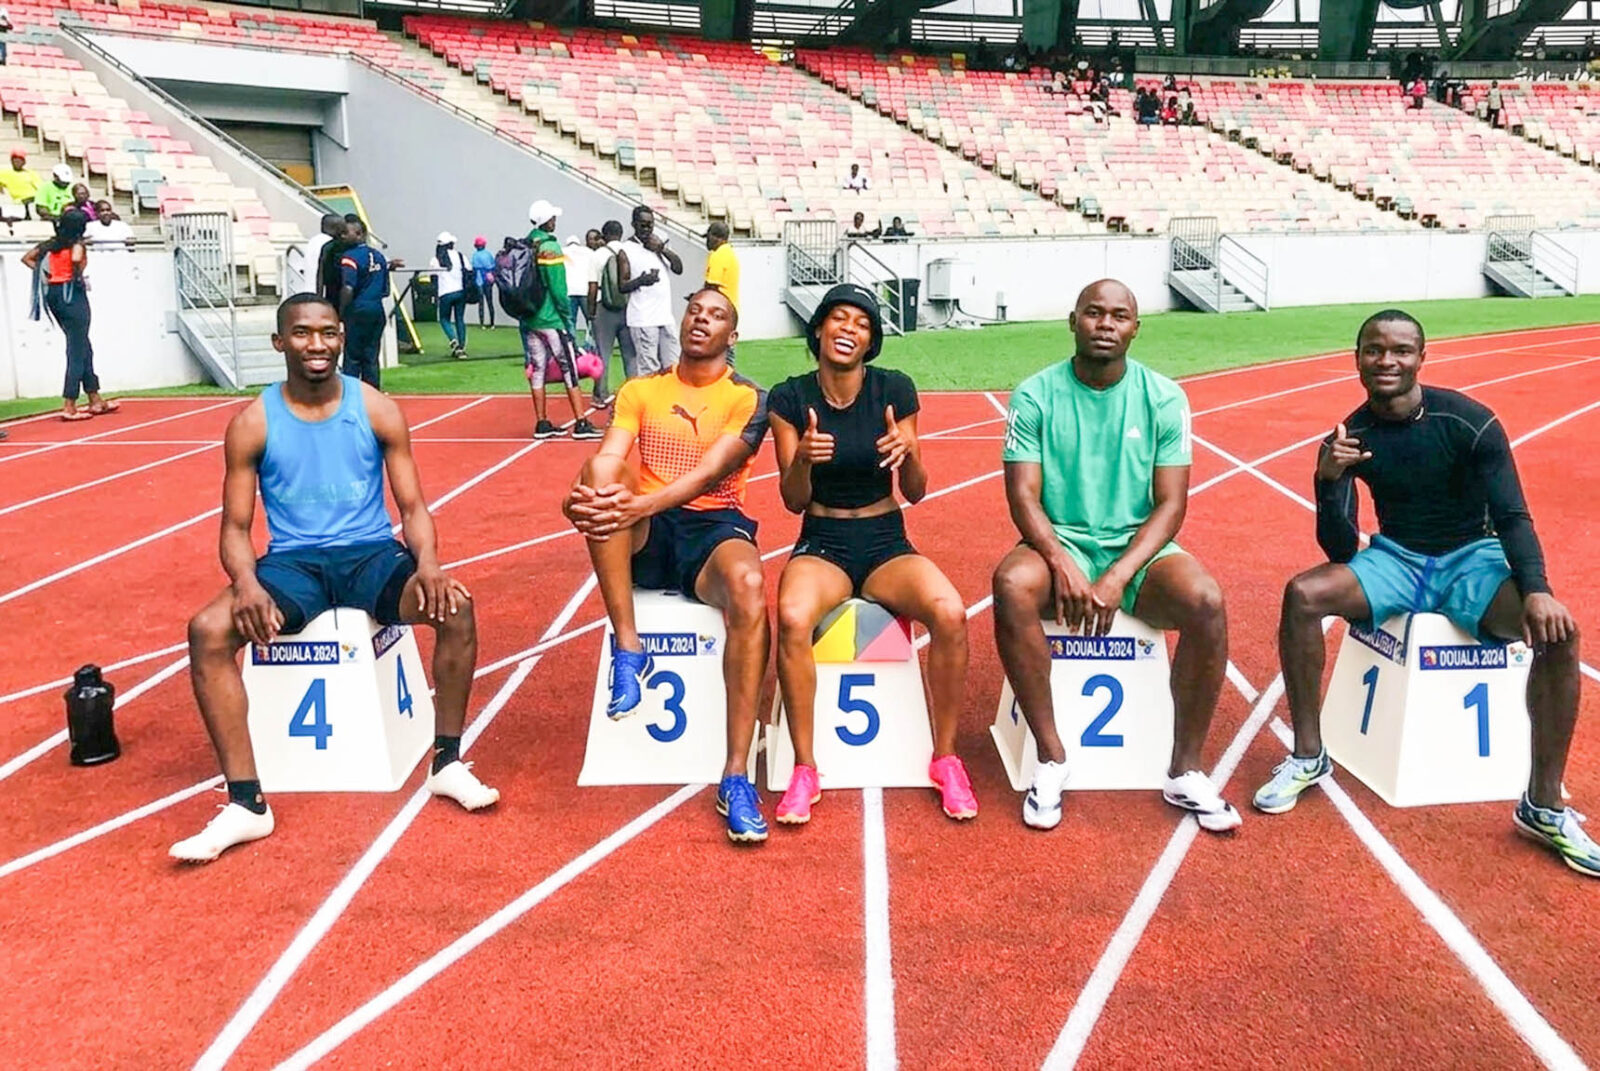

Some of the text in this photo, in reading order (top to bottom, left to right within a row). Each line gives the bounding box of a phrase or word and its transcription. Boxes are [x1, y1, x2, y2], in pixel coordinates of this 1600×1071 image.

[313, 645, 337, 661] 2024
[639, 637, 670, 653] UALA
[671, 636, 695, 653] 2024
[1066, 640, 1133, 657] DOUALA 2024
[1440, 648, 1505, 667] DOUALA 2024
[288, 678, 333, 750] 4
[397, 653, 414, 719] 4
[645, 670, 688, 743] 3
[834, 673, 881, 747] 5
[1080, 673, 1124, 747] 2
[1360, 665, 1380, 735] 1
[1463, 682, 1490, 757] 1
